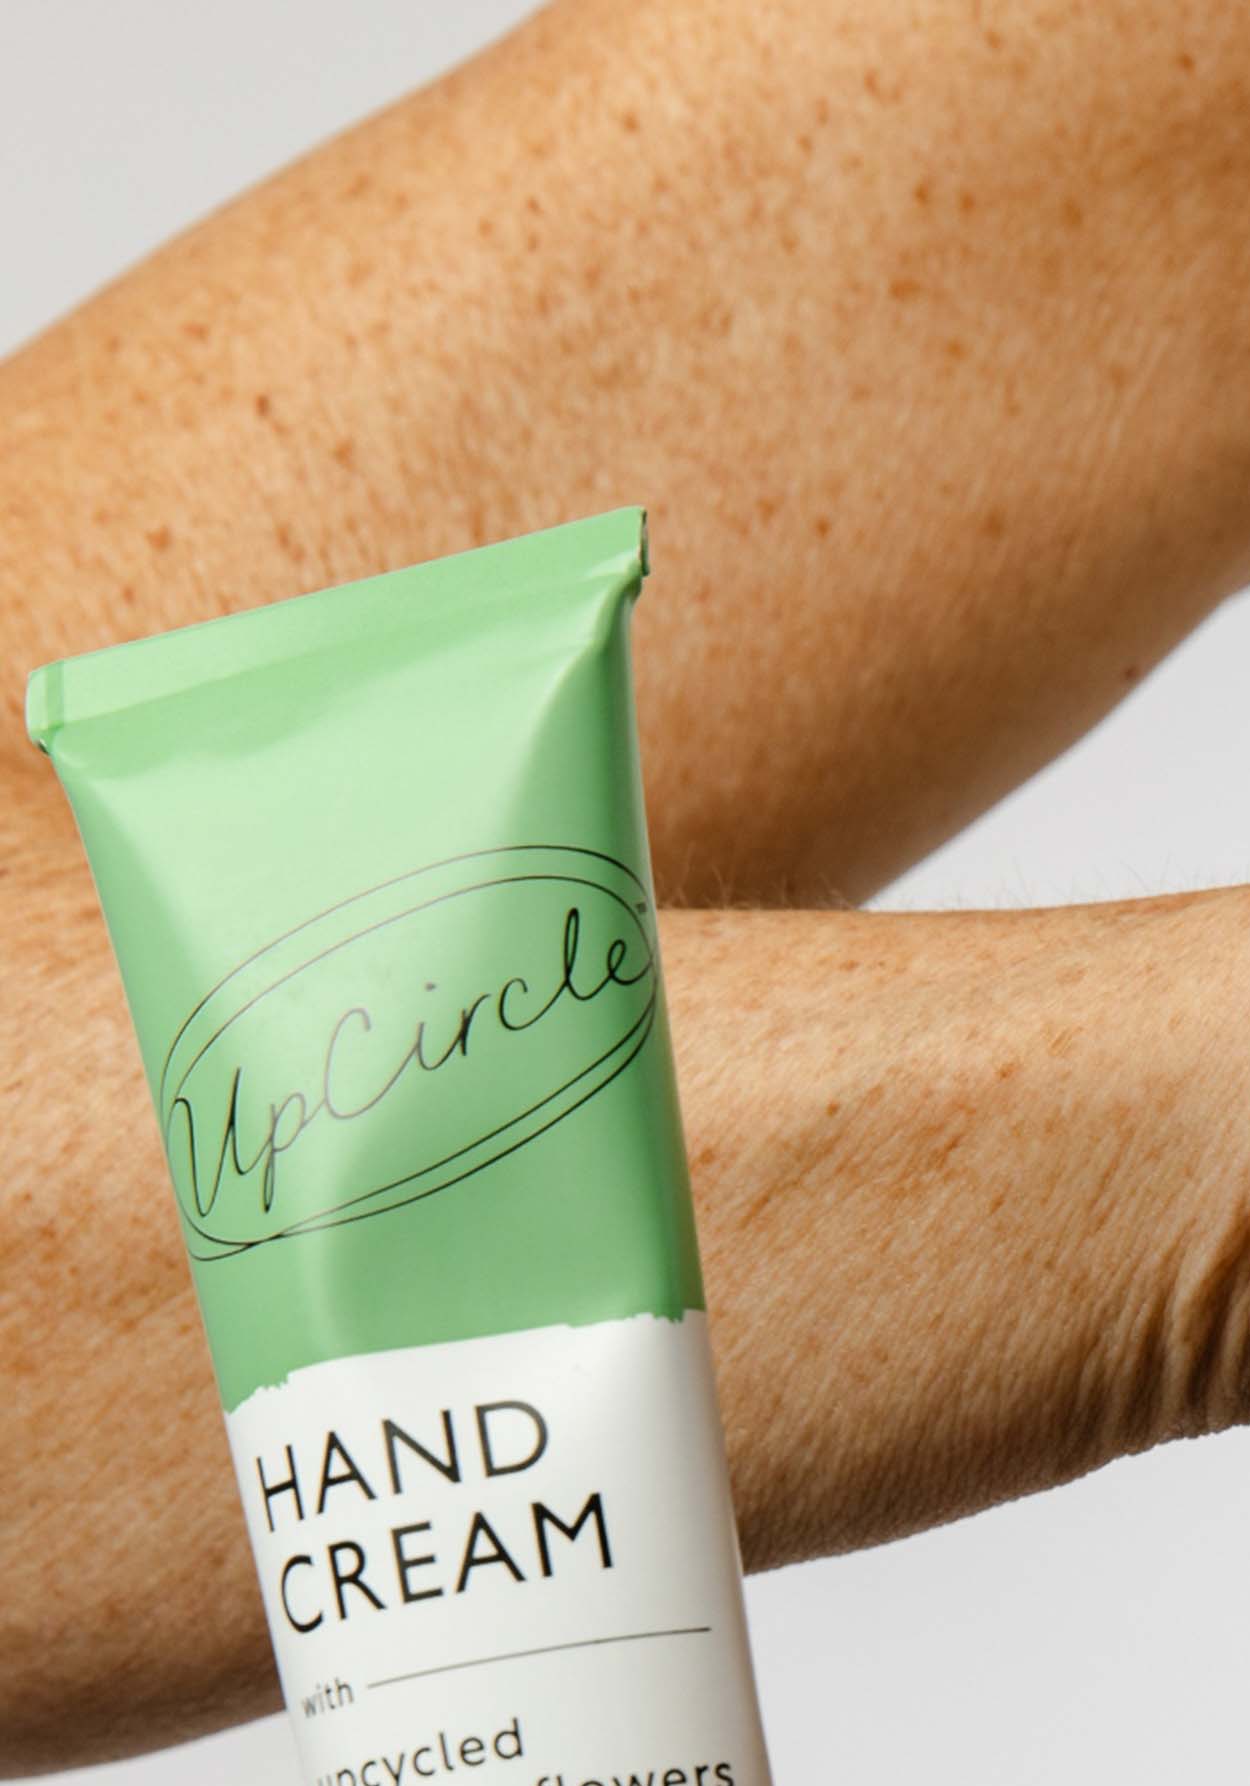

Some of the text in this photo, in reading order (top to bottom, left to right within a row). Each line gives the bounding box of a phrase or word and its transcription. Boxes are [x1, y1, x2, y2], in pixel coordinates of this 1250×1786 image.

[171, 907, 653, 1218] UpCircle
[255, 1400, 549, 1532] HAND
[279, 1491, 614, 1635] CREAM
[302, 1677, 354, 1718] with
